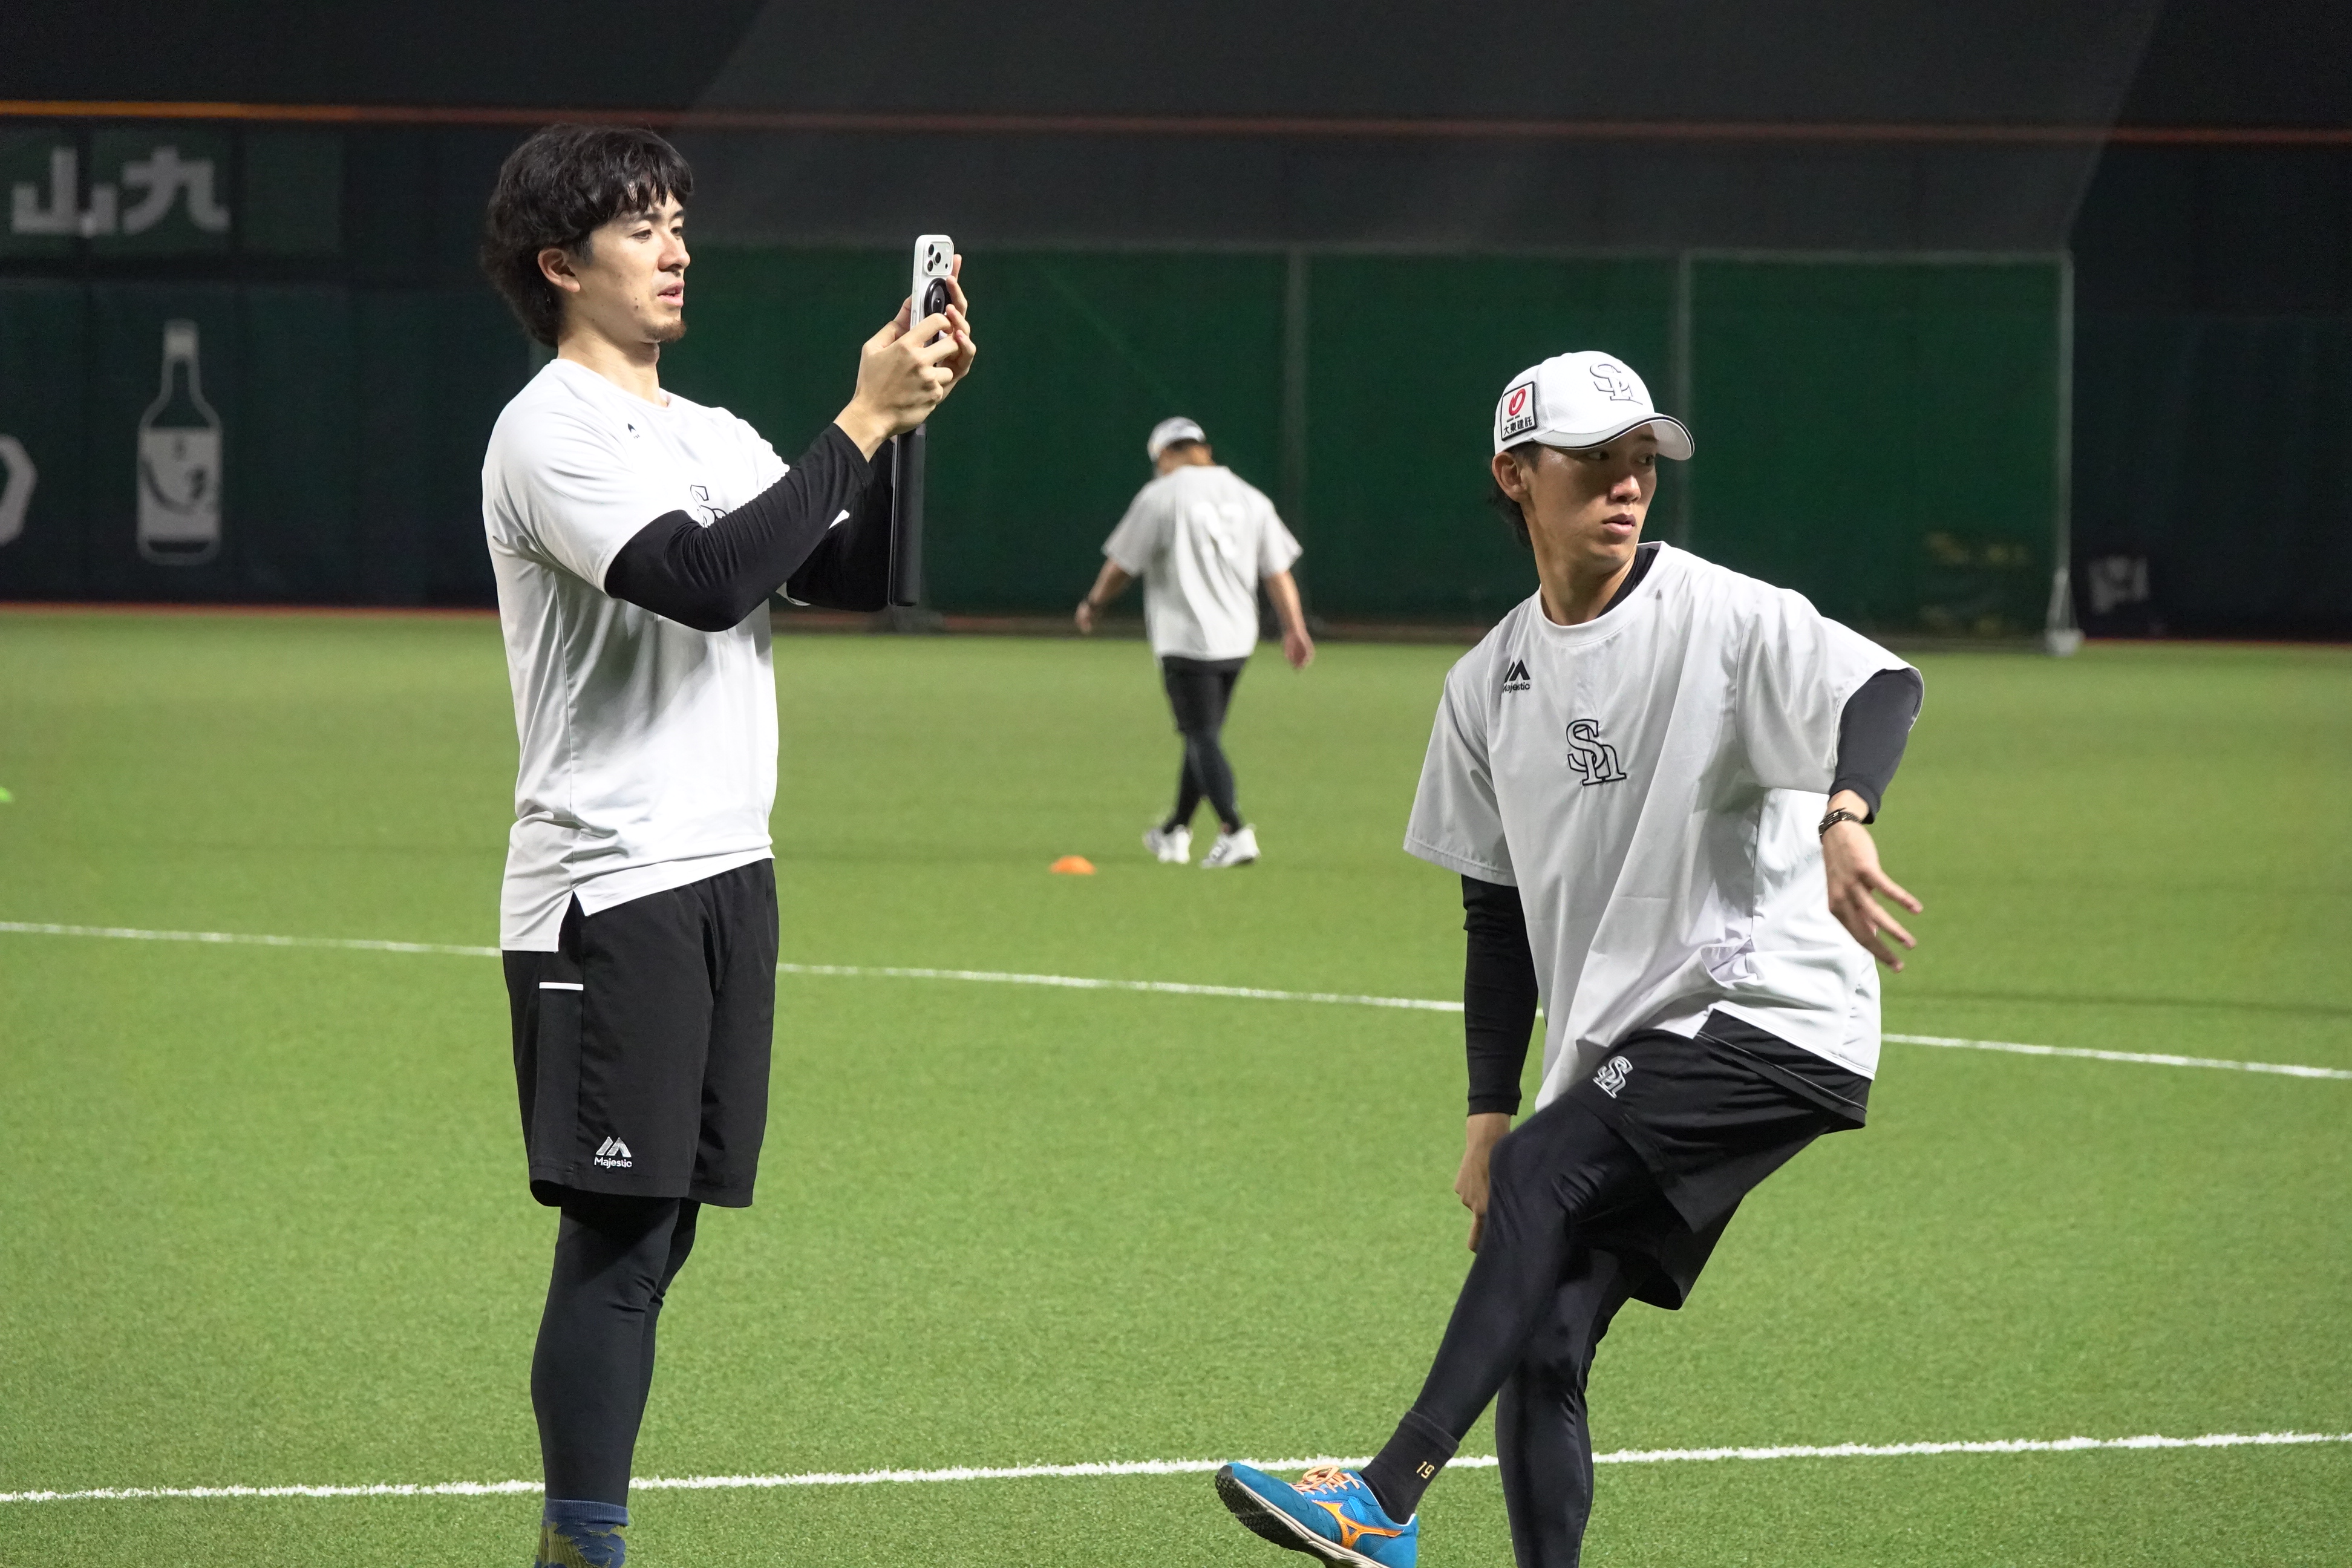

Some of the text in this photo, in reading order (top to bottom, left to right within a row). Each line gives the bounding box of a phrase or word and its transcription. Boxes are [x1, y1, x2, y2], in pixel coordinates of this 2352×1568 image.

[10, 145, 231, 236] 山九
[593, 1156, 632, 1169] Majestic
[1416, 1461, 1435, 1479] 19
